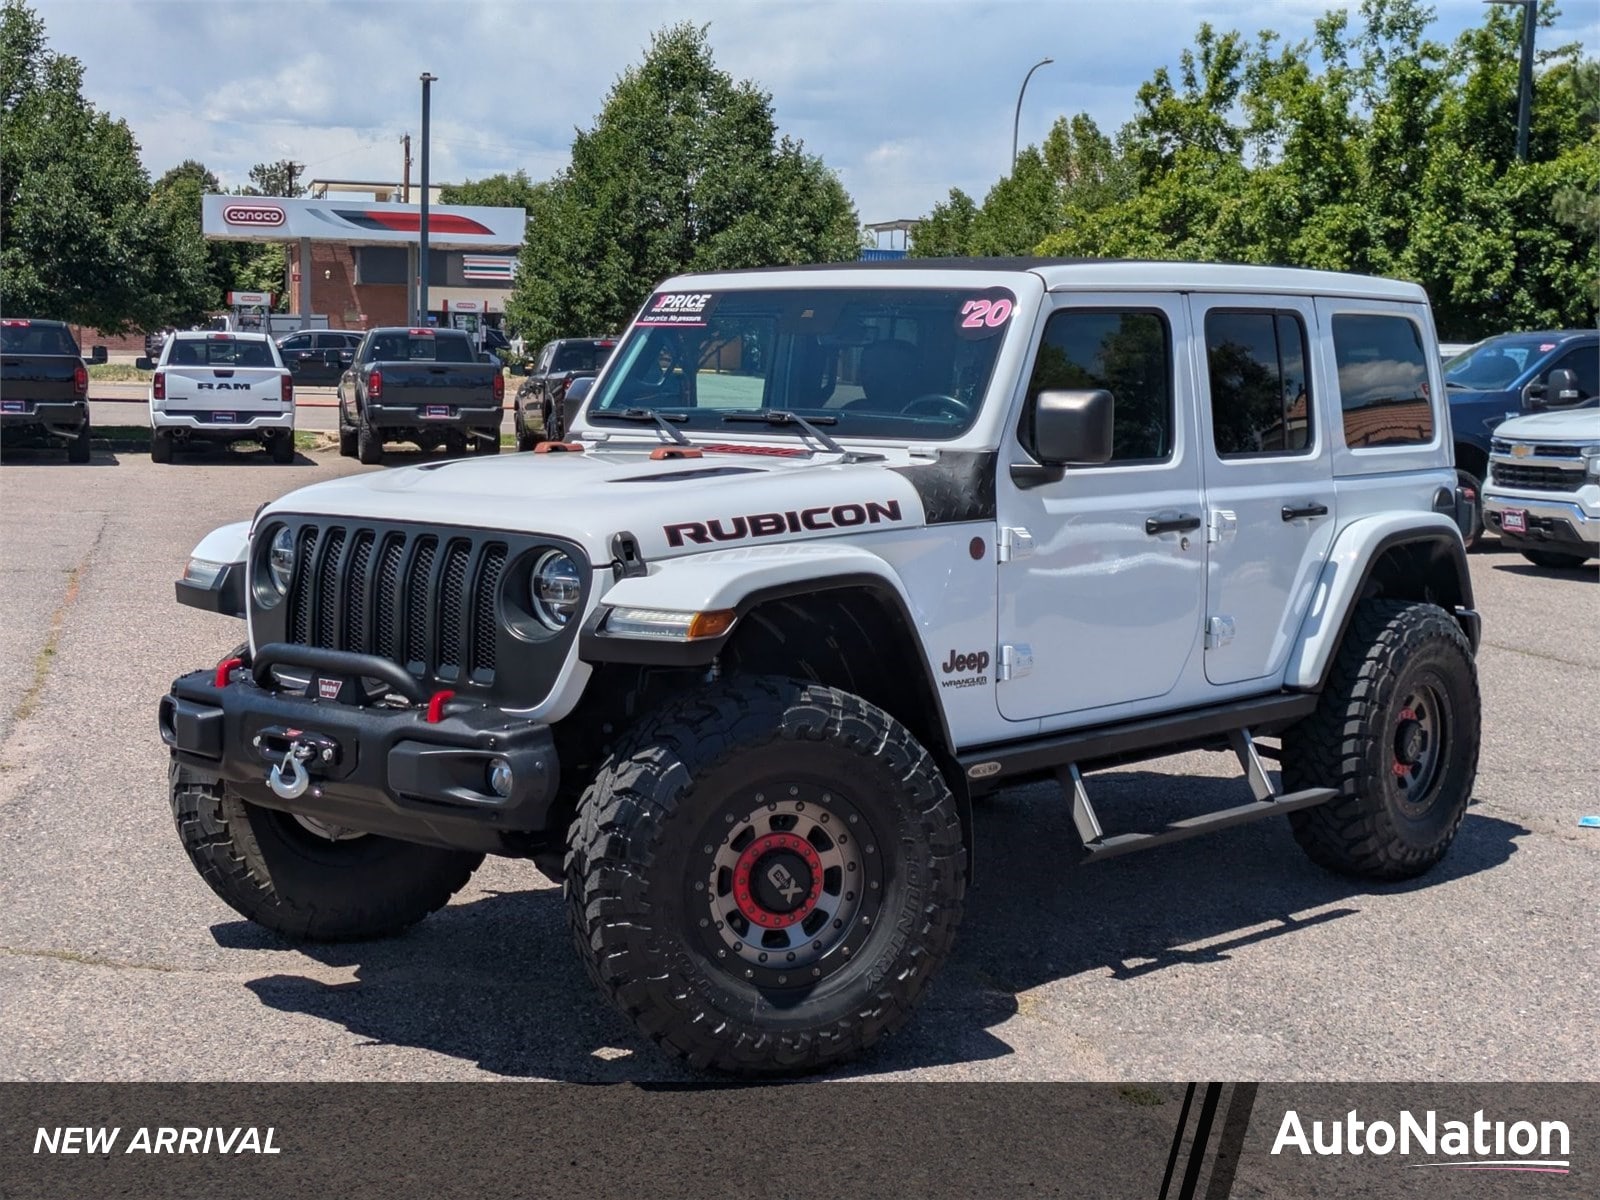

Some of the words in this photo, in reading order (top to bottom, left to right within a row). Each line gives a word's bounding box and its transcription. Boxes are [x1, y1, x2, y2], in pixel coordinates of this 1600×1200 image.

[663, 500, 903, 548] RUBICON
[942, 649, 990, 674] Jeep
[942, 676, 987, 687] WRANGLER
